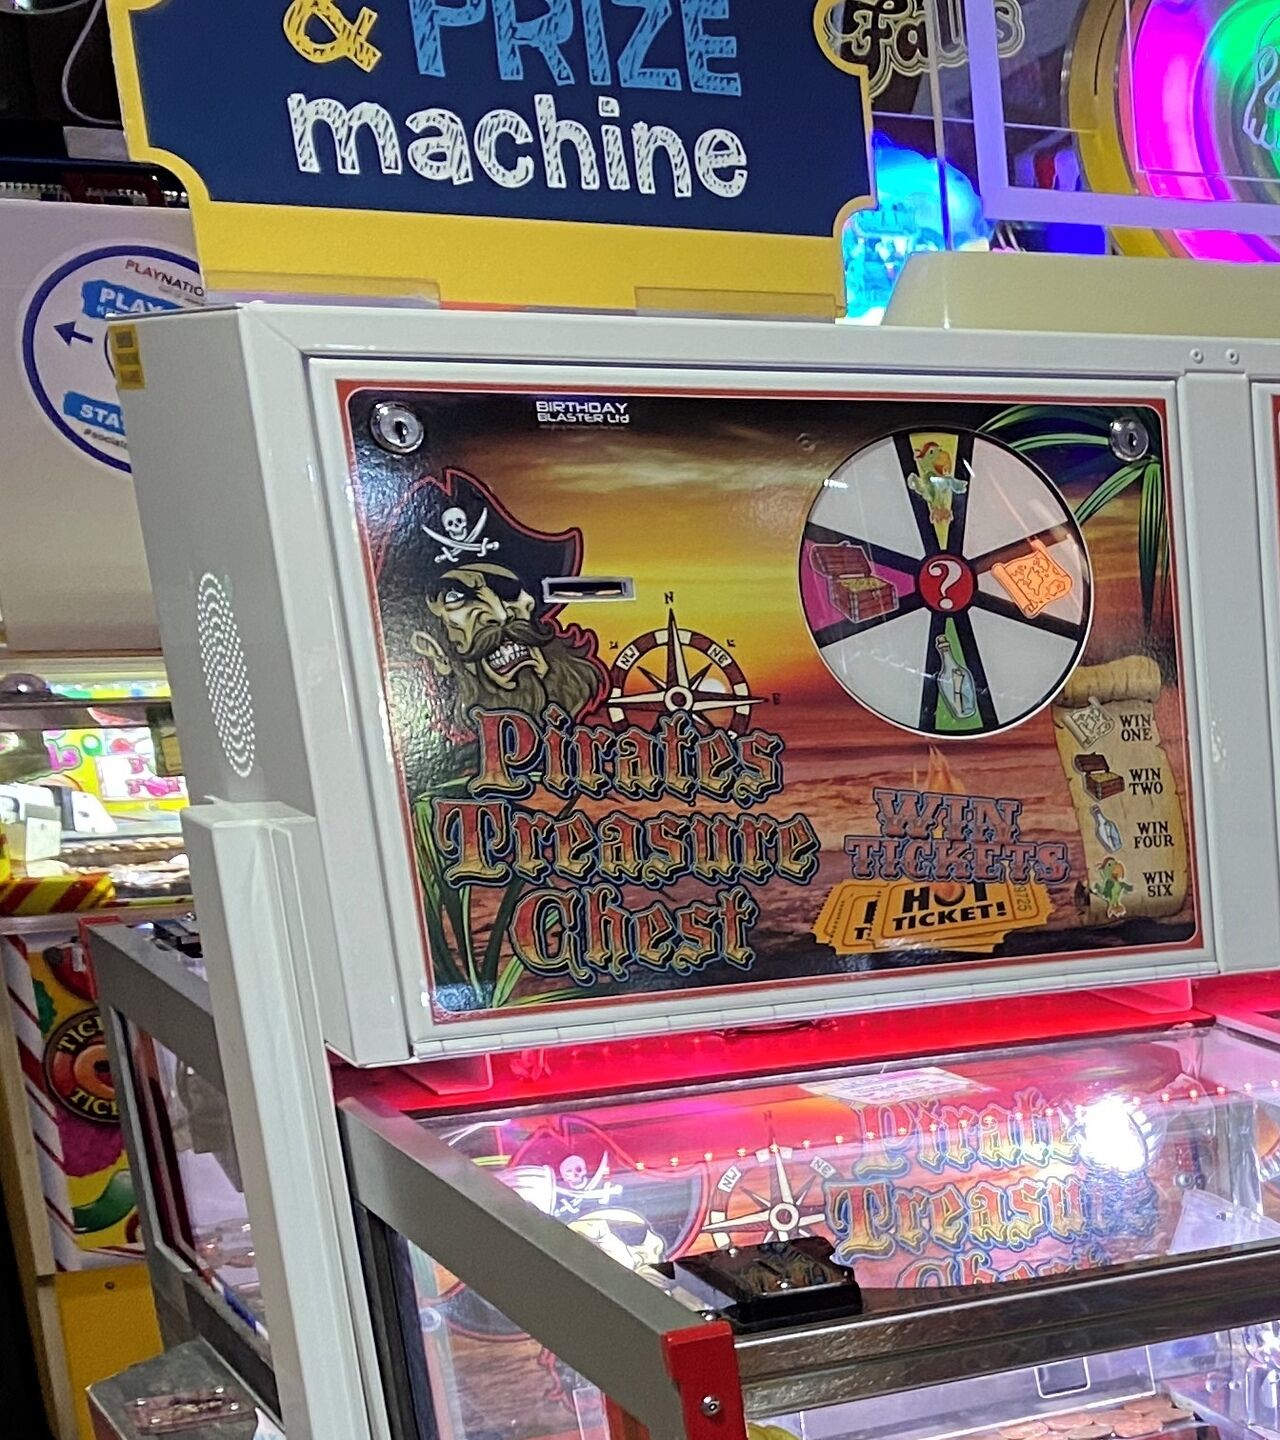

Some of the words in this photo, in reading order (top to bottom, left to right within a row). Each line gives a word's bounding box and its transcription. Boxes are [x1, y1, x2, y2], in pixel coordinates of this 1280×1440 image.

[410, 0, 743, 96] PRIZE
[286, 94, 748, 198] machine
[536, 401, 628, 414] BIRTHDAY
[537, 412, 604, 424] BLASTER
[606, 413, 630, 424] Ltd
[664, 591, 674, 604] N
[1120, 714, 1152, 728] WIN
[1120, 727, 1153, 742] ONE
[468, 705, 784, 807] Pirates
[1129, 768, 1161, 781] WIN
[1129, 781, 1163, 795] TWO
[873, 787, 1022, 843] WIN
[1137, 820, 1169, 834] WIN
[432, 798, 820, 888] Treasure
[1134, 834, 1175, 848] FOUR
[844, 835, 1070, 884] TICKETS
[1142, 870, 1175, 885] WIN
[1147, 883, 1173, 897] SIX
[892, 901, 1006, 932] TICKET!
[509, 885, 759, 987] Chest
[810, 1155, 837, 1178] NE
